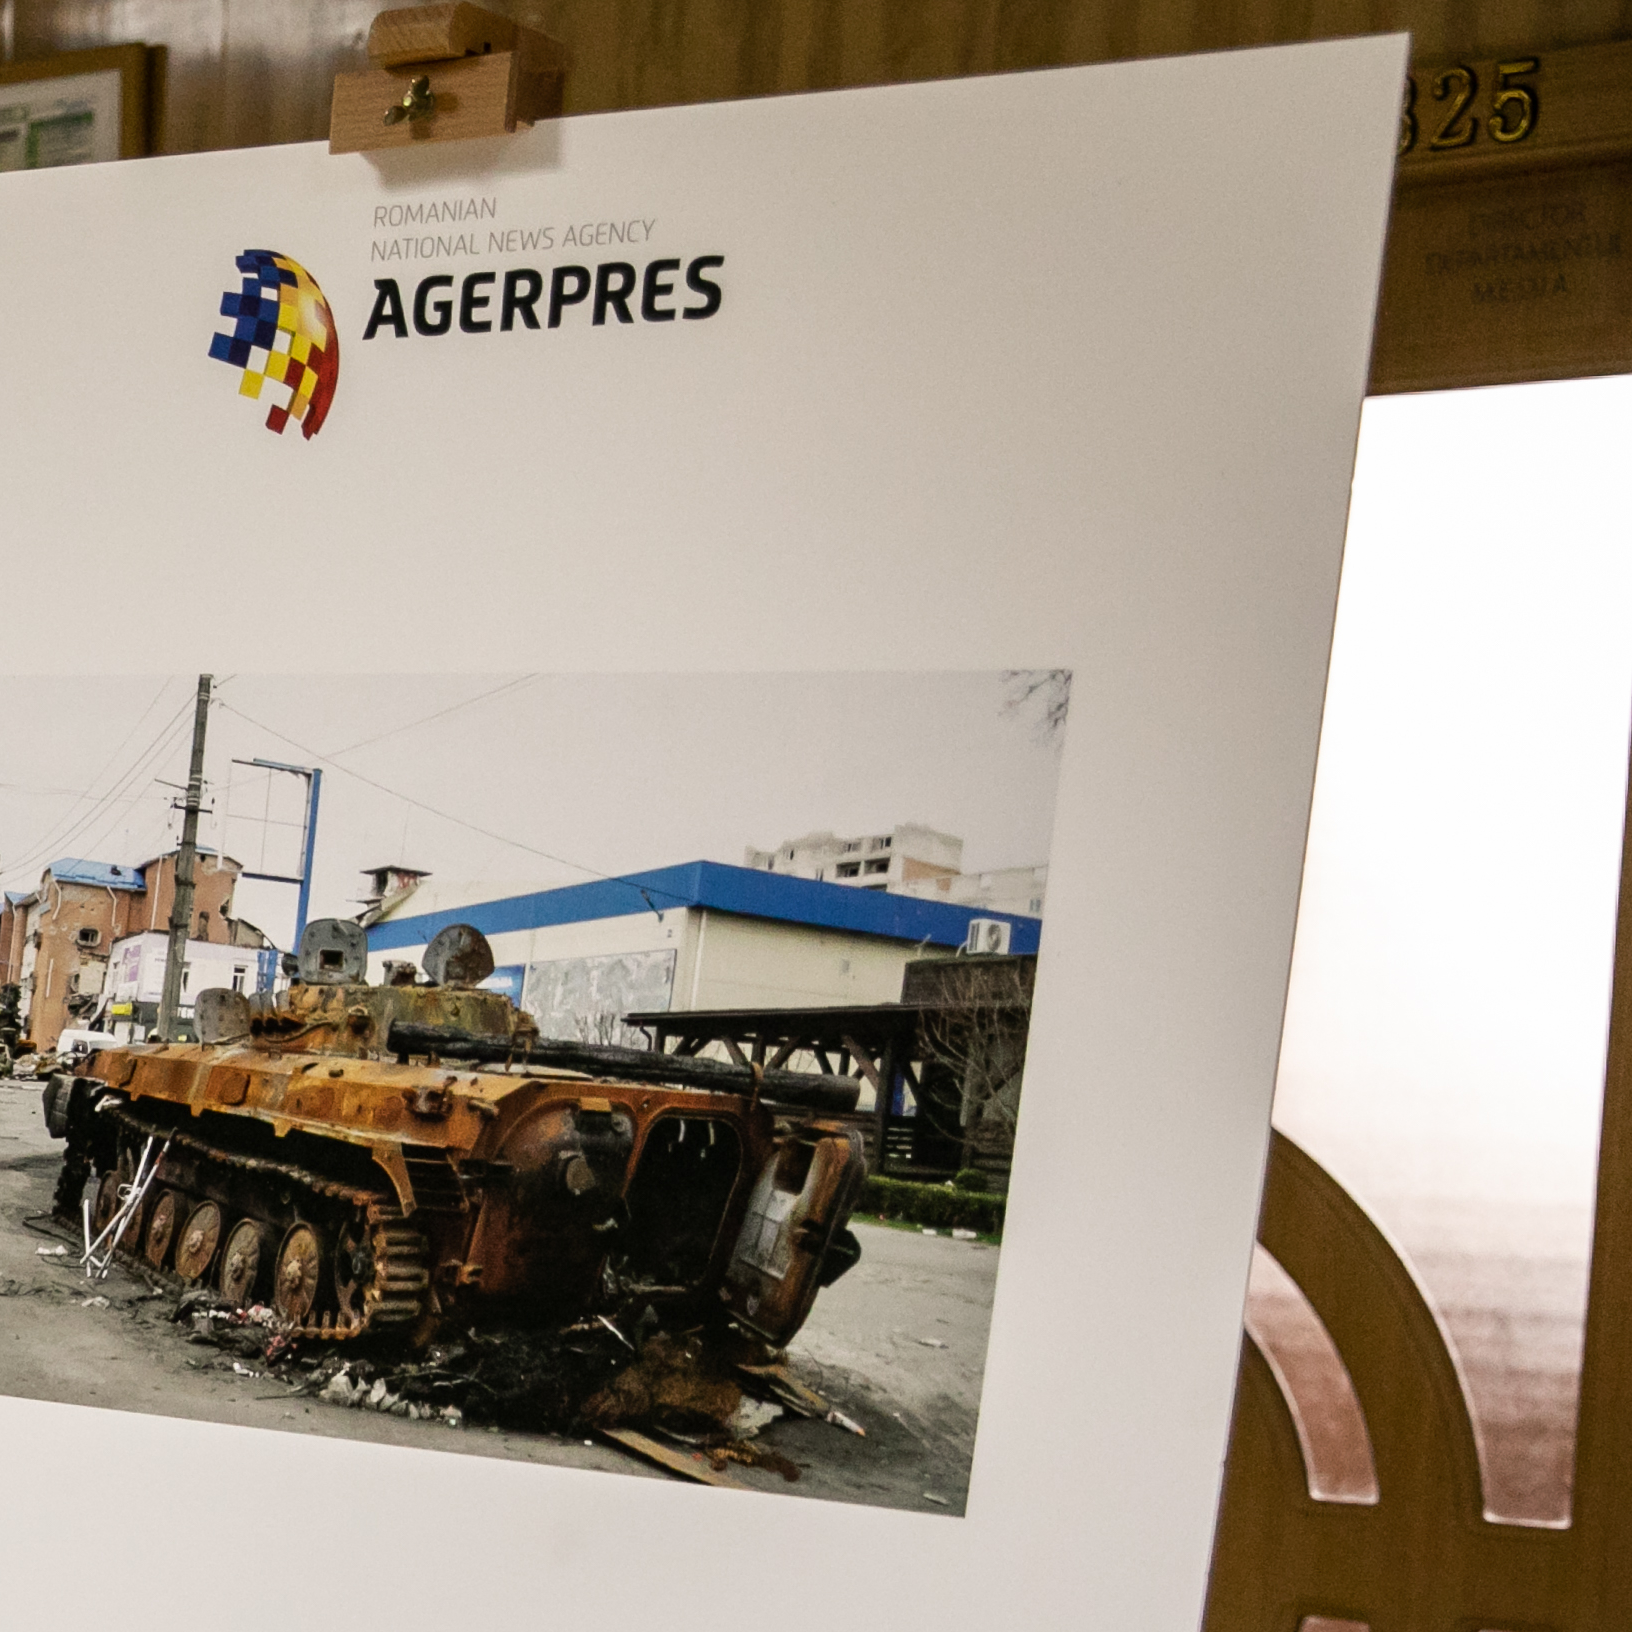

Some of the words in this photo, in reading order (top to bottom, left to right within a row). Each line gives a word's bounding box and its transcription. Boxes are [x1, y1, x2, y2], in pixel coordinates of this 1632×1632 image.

[374, 197, 496, 228] ROMANIAN
[371, 233, 480, 262] NATIONAL
[488, 227, 554, 253] NEWS
[562, 219, 656, 247] AGENCY
[363, 255, 724, 340] AGERPRES
